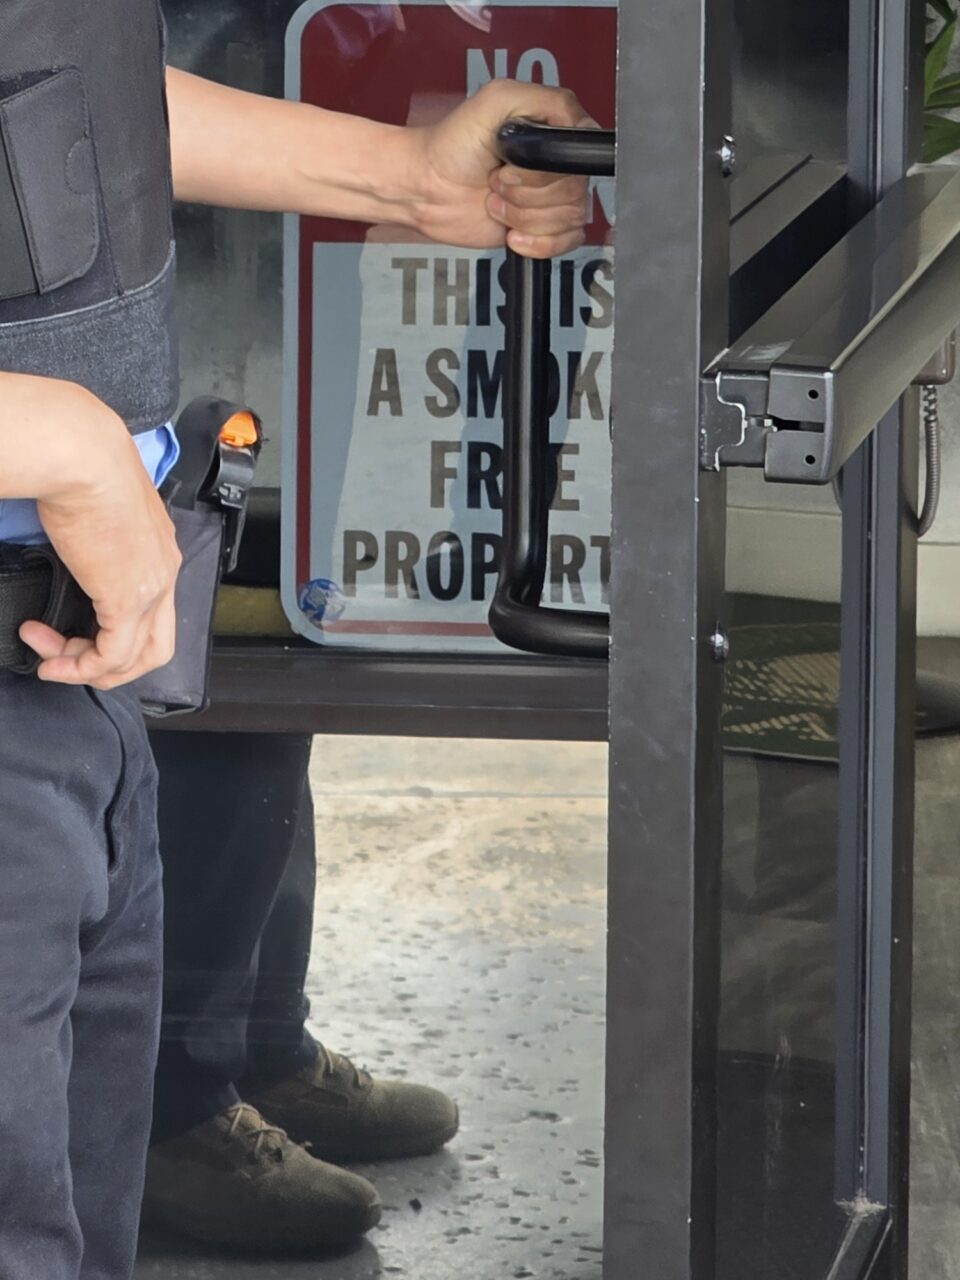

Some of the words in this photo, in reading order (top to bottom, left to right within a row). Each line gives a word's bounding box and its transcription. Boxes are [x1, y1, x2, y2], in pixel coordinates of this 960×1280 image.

[392, 257, 506, 326] THI
[559, 259, 615, 330] IS
[366, 347, 404, 417] A
[430, 440, 580, 512] FRE
[342, 528, 613, 606] PROPRT
